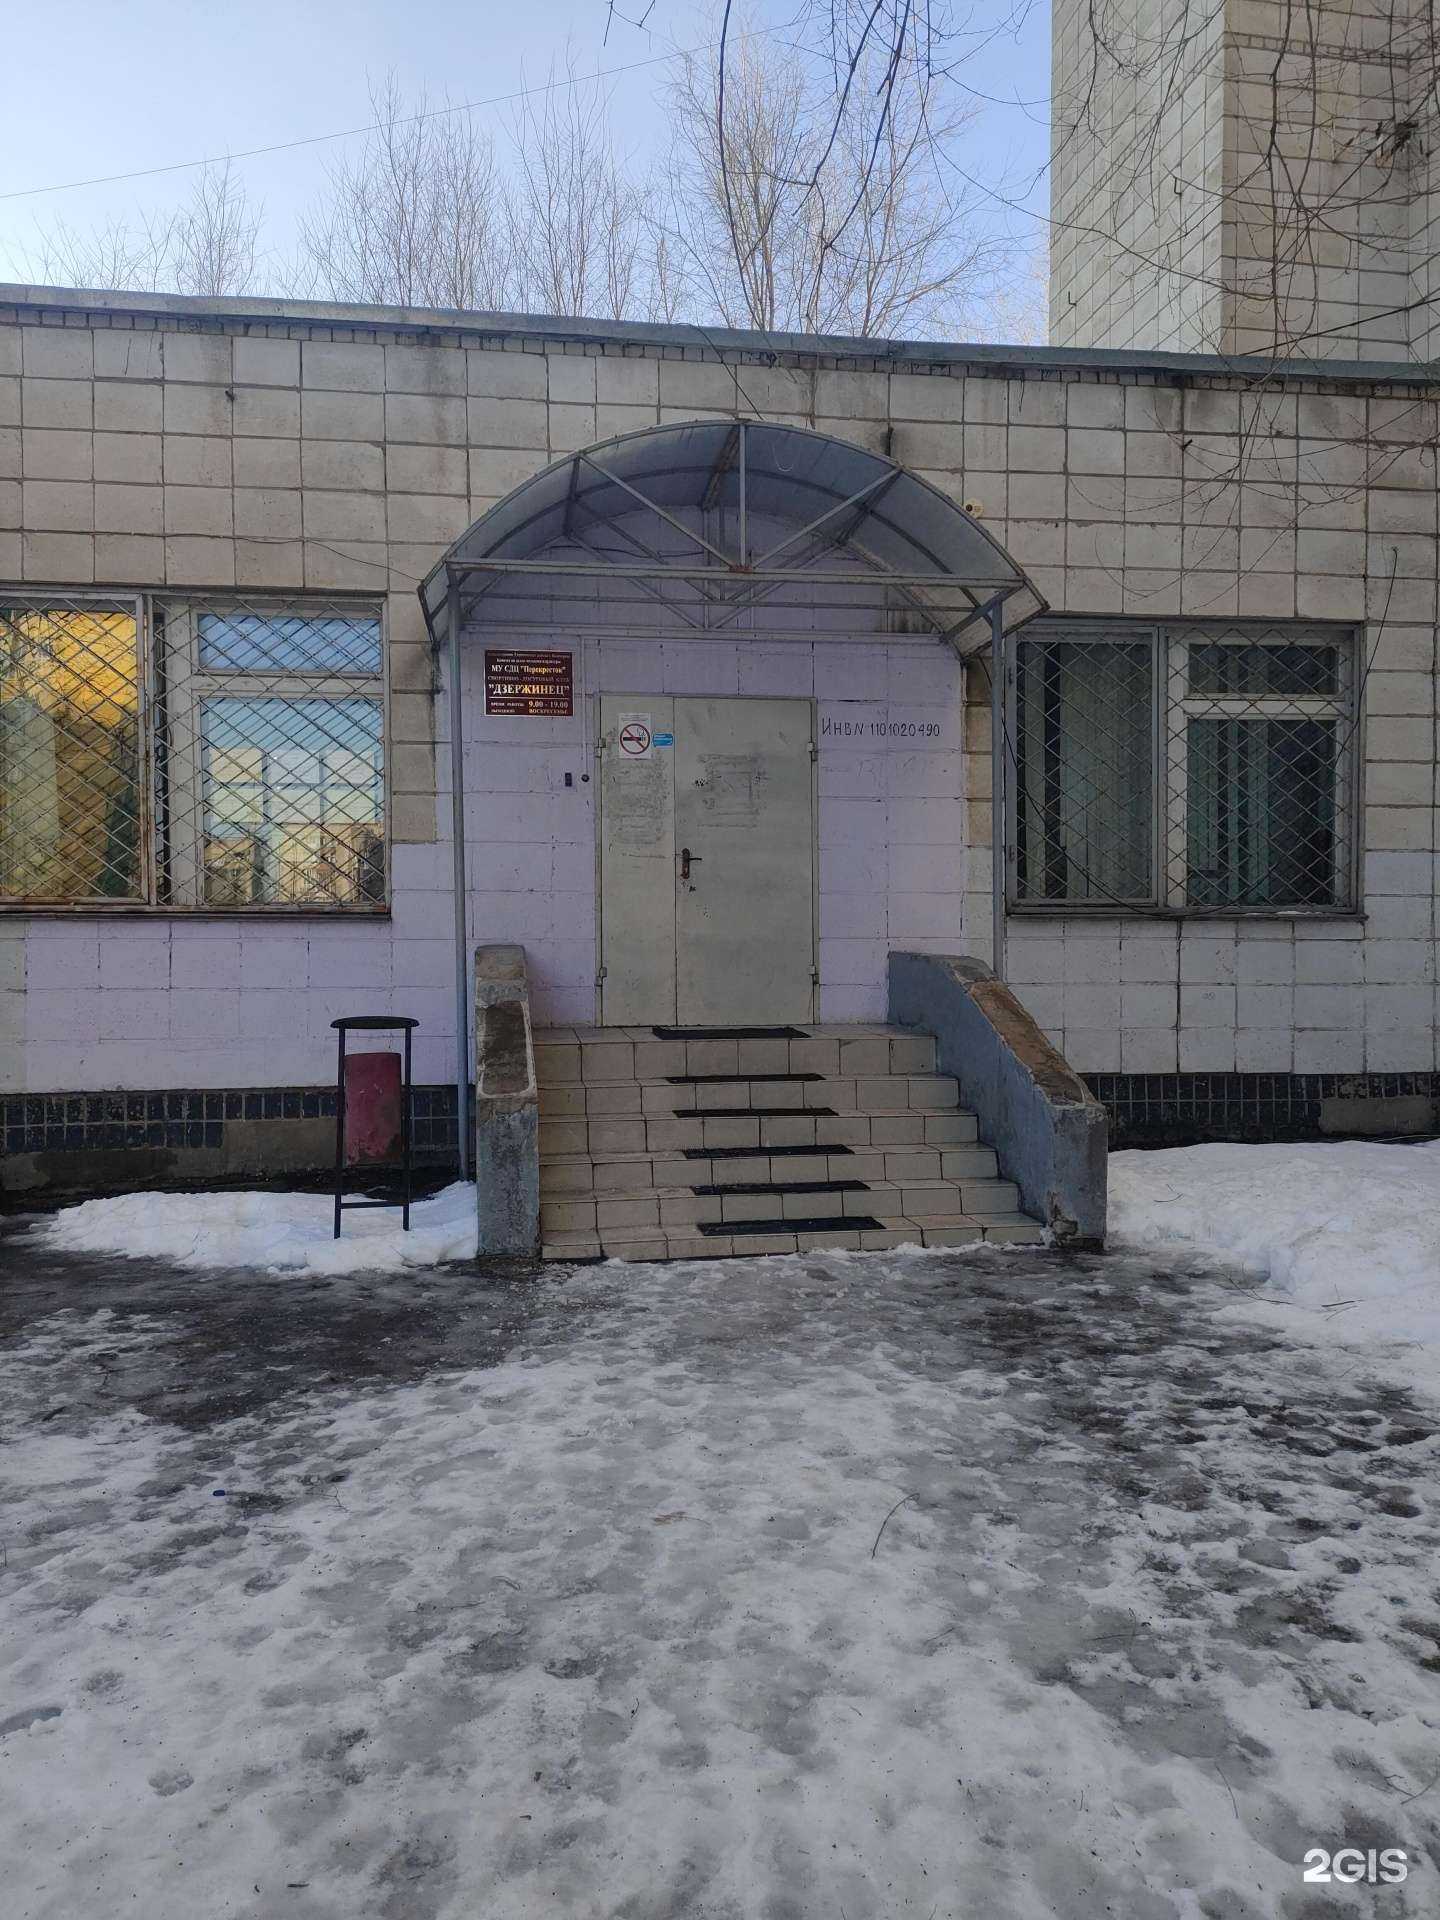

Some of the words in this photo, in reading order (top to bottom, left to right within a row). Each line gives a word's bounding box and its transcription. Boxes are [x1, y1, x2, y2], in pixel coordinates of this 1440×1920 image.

[491, 664, 503, 672] МУ
[504, 664, 519, 674] СДЦ
[488, 683, 570, 696] "ДЗЕРЖИНЕЦ"
[528, 700, 544, 708] 9.00
[550, 701, 569, 709] 19.00
[870, 723, 940, 737] 1101020490
